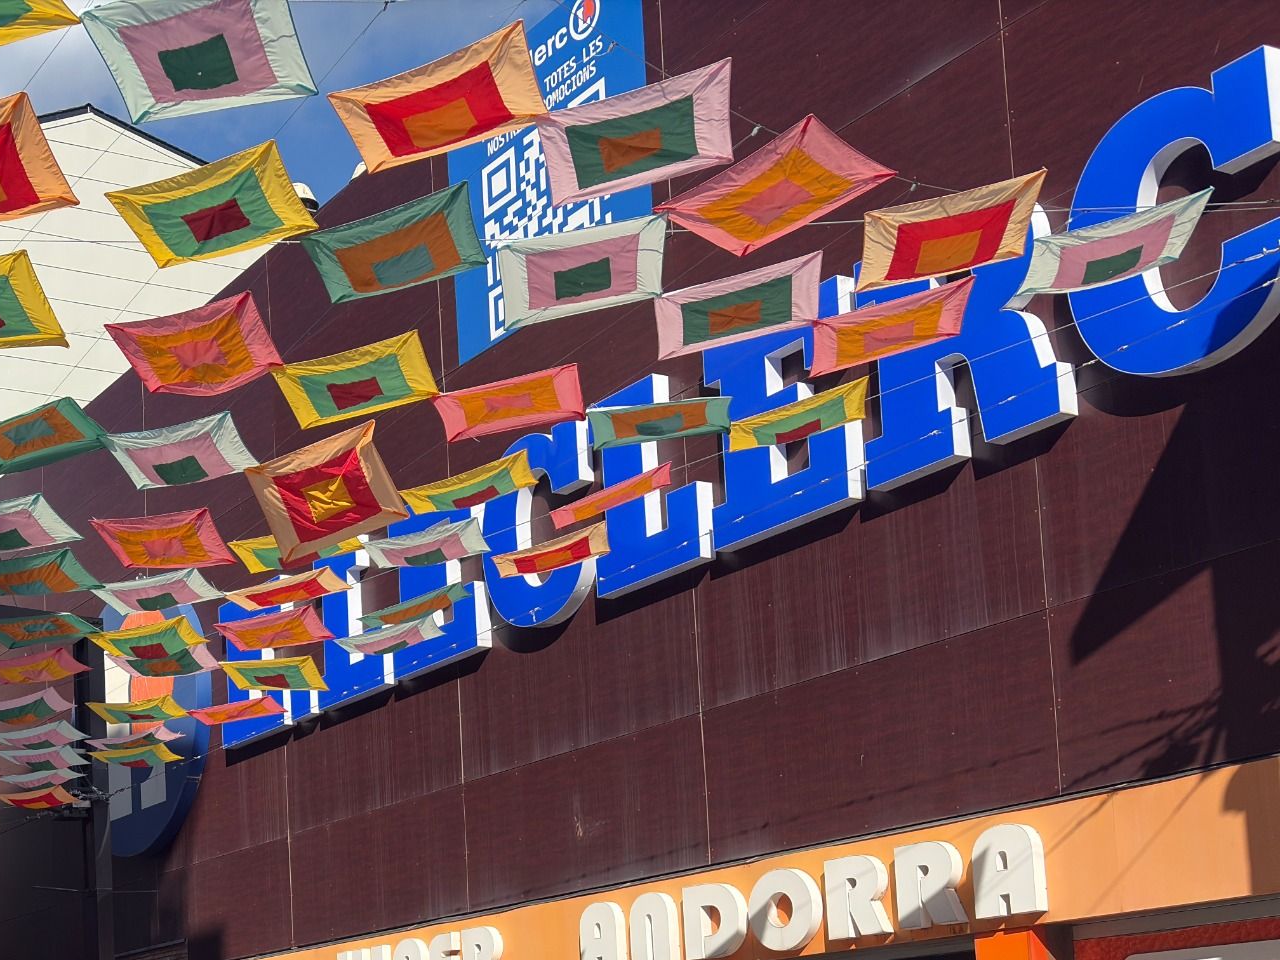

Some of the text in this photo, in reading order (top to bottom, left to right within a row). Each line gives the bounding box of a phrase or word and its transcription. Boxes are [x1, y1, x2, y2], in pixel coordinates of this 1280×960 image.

[544, 34, 604, 92] TOTES LES
[544, 60, 598, 111] OMOCIONS
[487, 127, 526, 156] NOST
